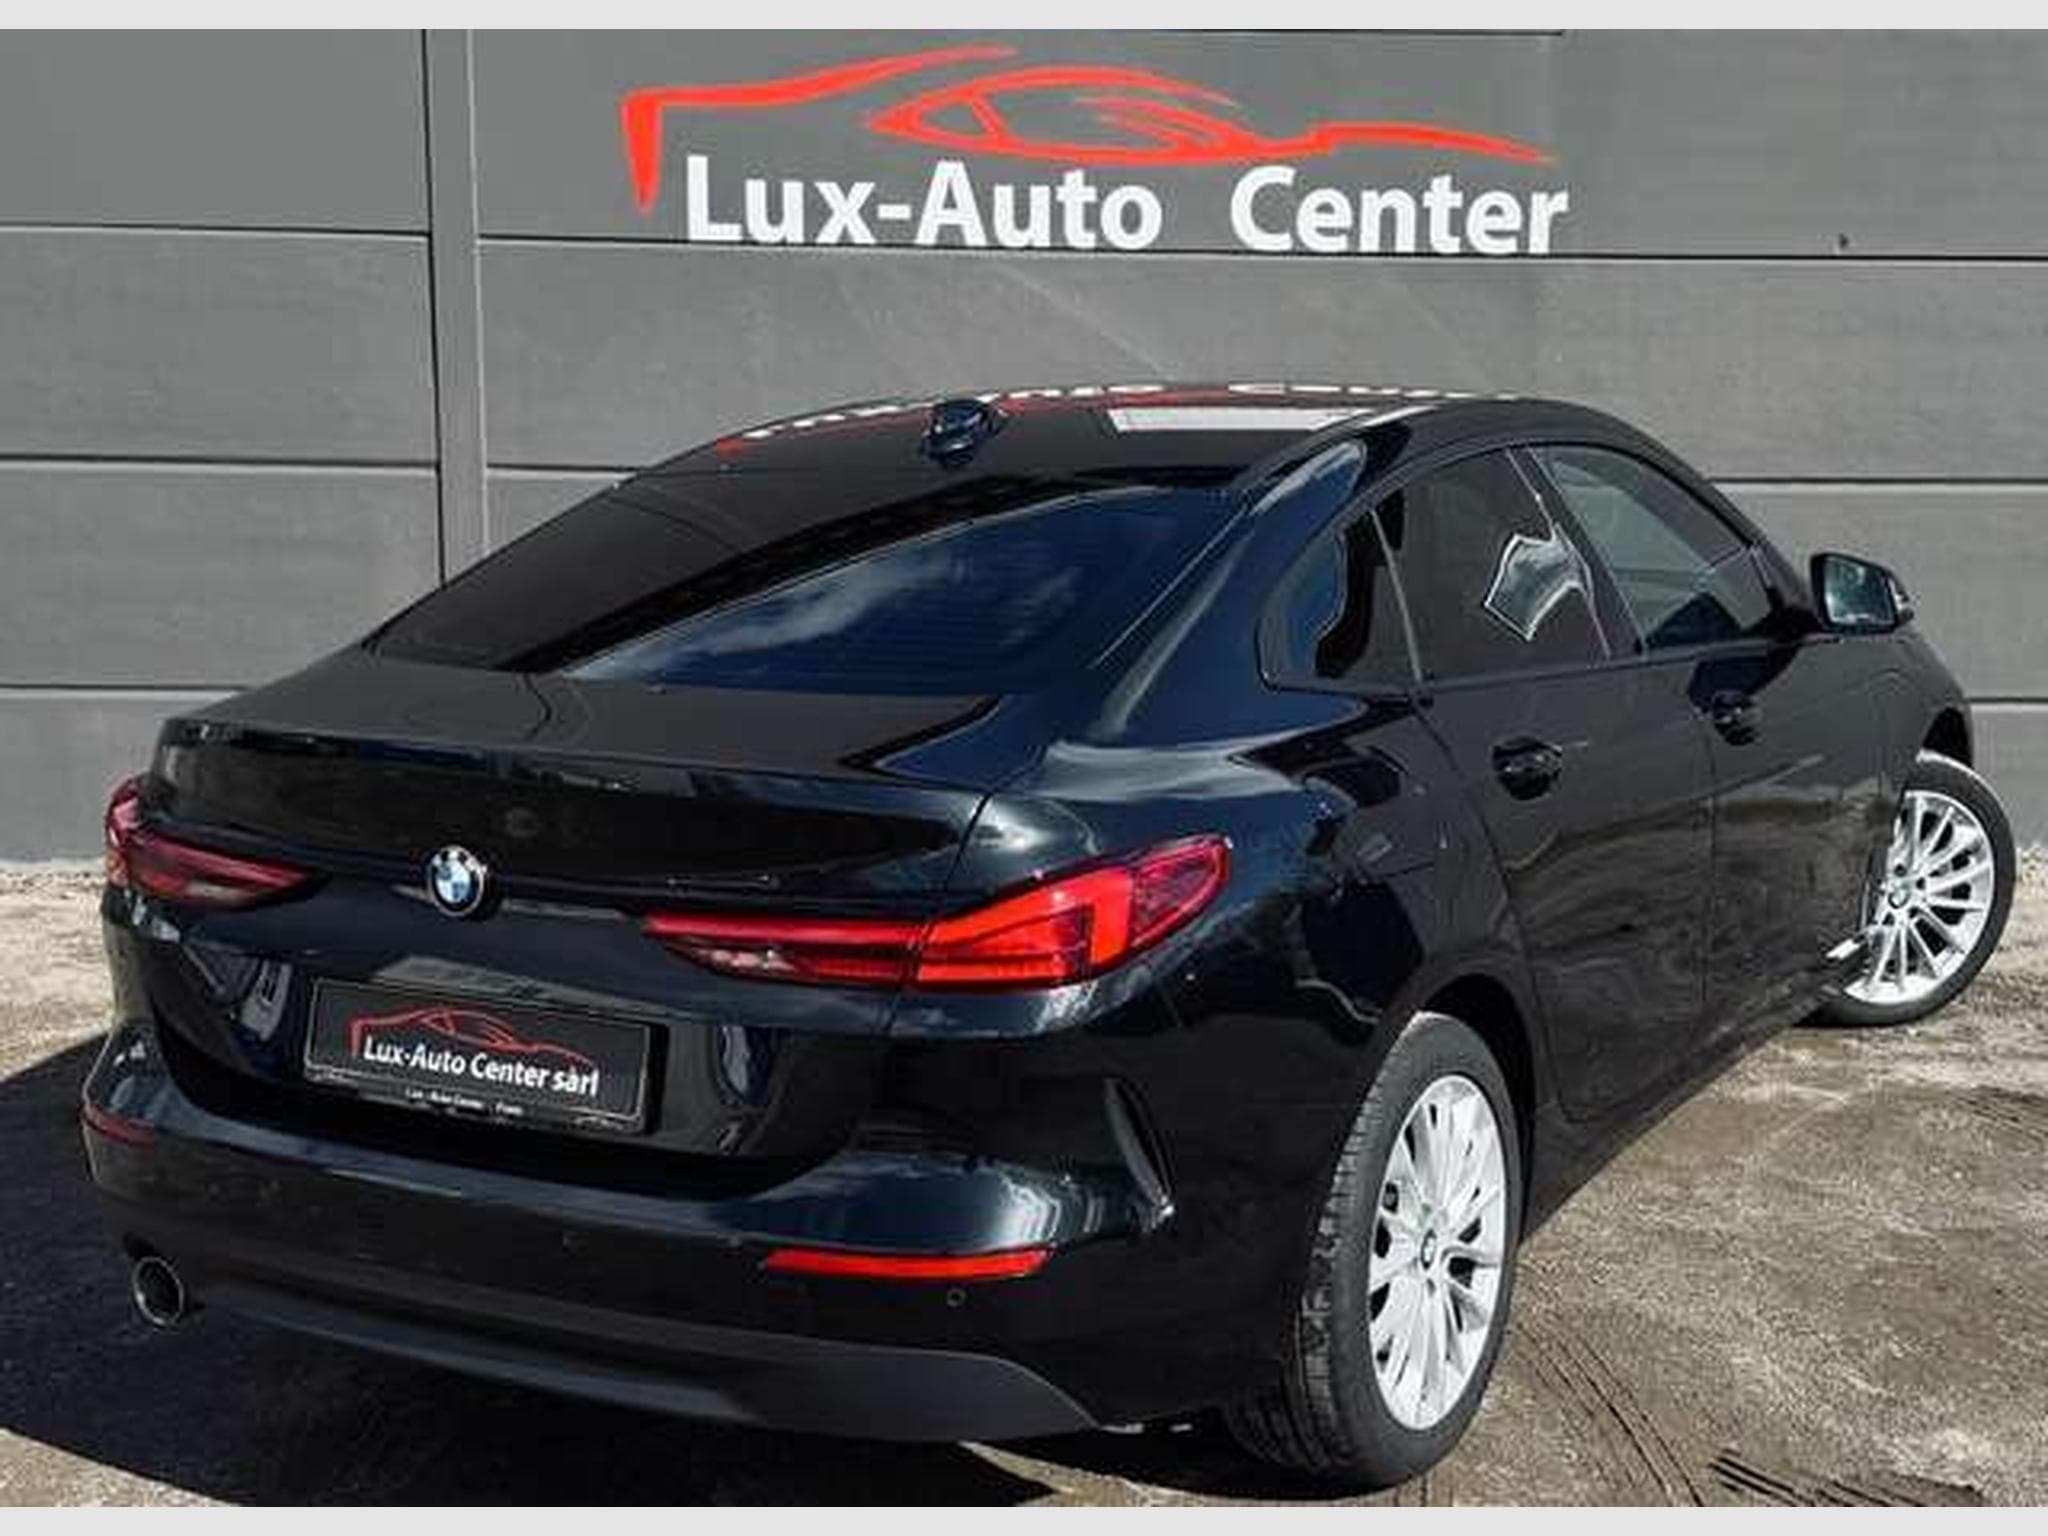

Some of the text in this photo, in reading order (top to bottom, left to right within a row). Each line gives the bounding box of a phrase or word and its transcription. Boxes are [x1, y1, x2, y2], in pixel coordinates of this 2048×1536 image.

[686, 154, 1570, 255] Lux-Auto Center
[363, 1034, 467, 1075] Lux-Auto
[469, 1052, 550, 1088] Center
